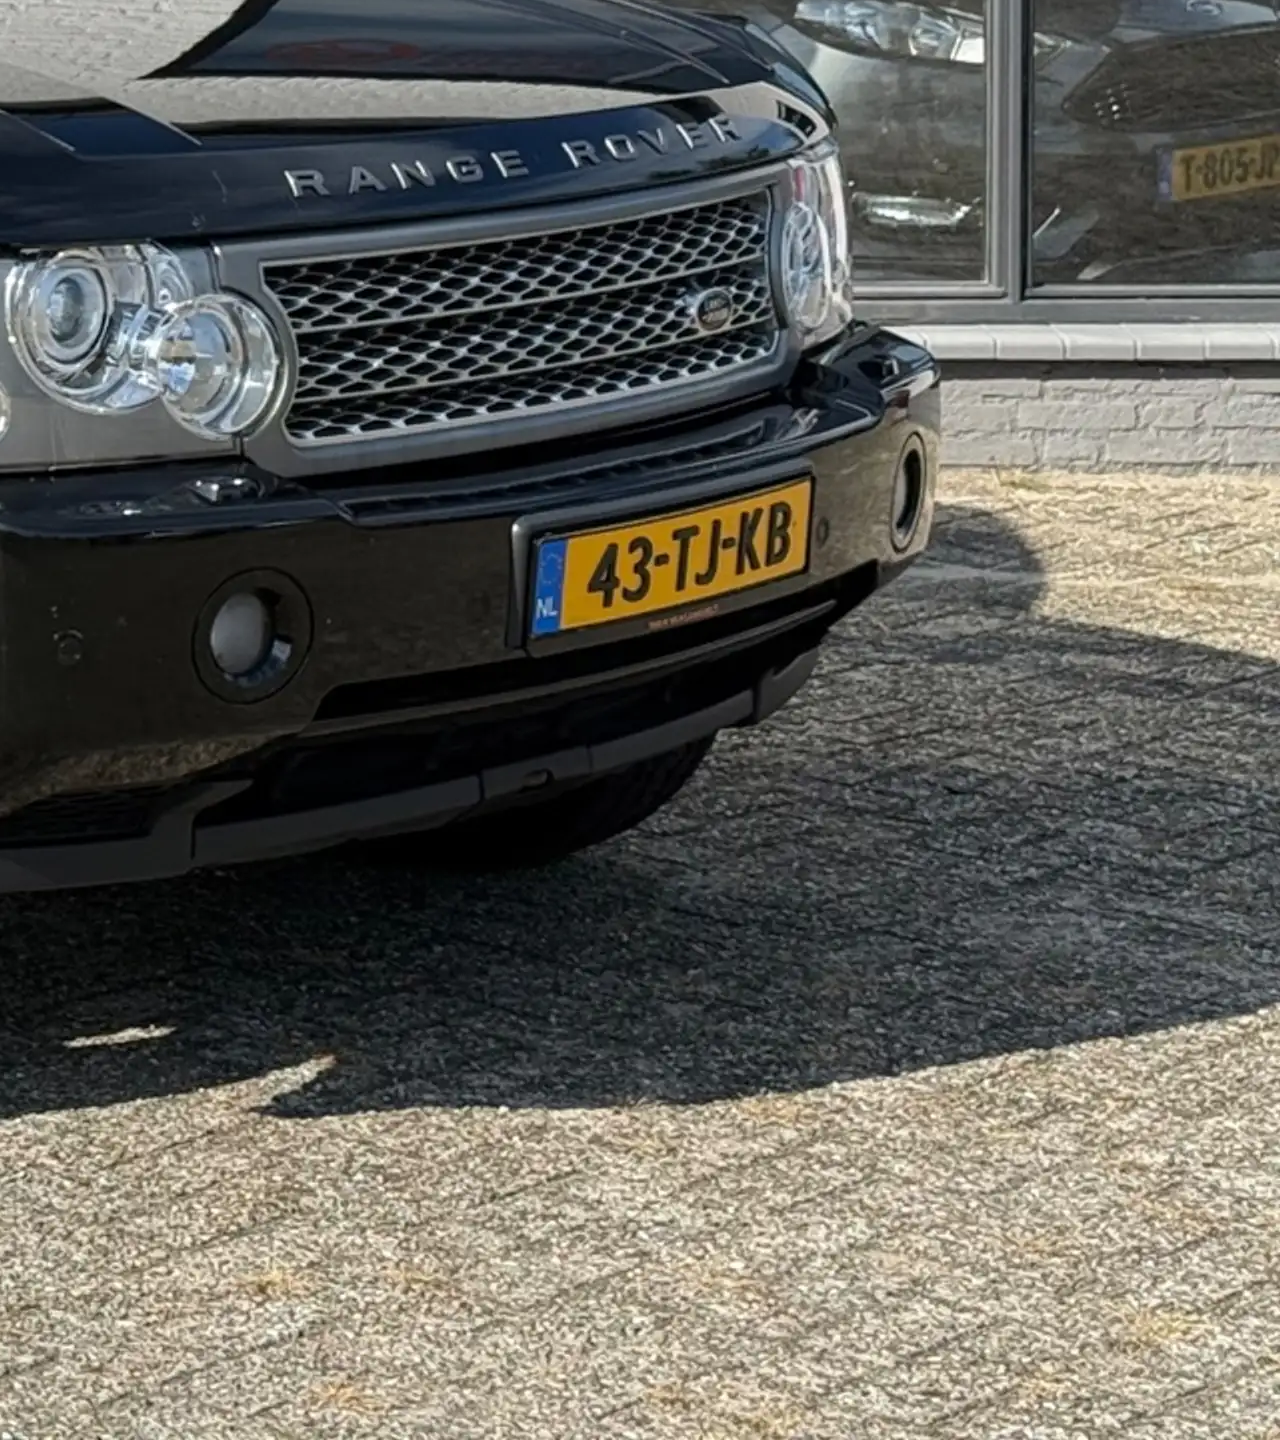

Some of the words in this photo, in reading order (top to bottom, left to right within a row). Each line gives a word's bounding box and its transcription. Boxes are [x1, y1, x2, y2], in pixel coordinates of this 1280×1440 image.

[283, 151, 530, 200] RANGE
[562, 116, 742, 169] ROVER
[586, 500, 794, 609] 43-TJ-KB
[535, 595, 560, 620] NL
